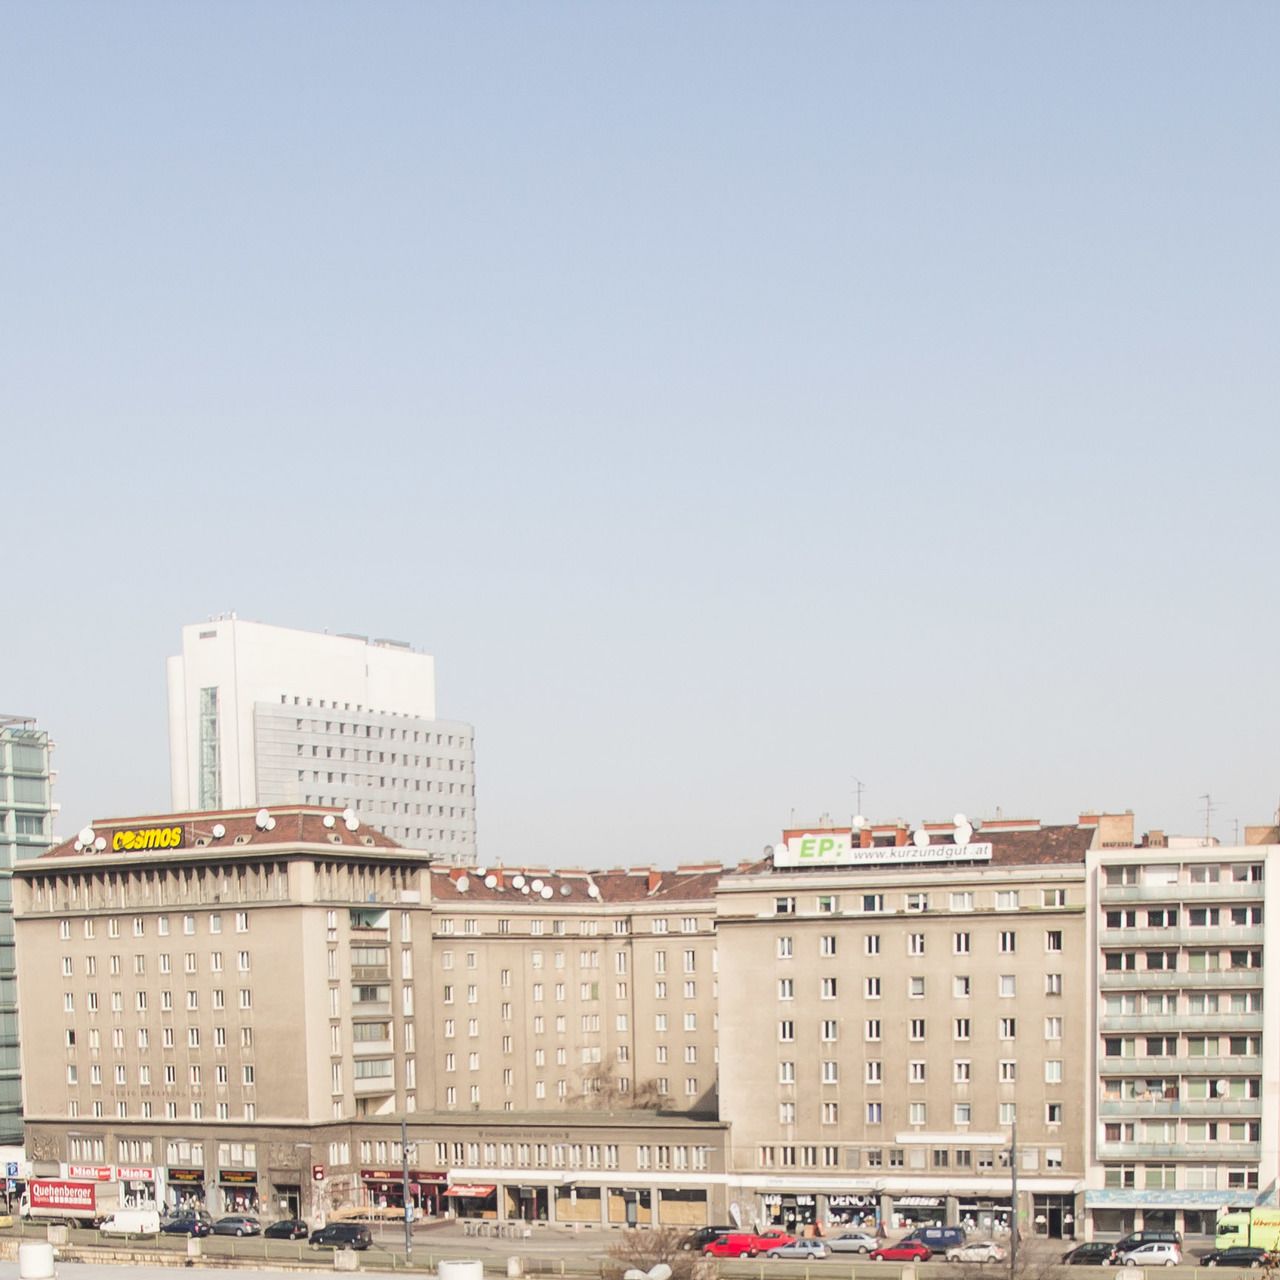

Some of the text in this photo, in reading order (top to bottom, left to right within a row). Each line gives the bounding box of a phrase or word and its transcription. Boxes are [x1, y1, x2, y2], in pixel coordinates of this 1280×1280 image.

[799, 838, 843, 858] EP:
[853, 843, 989, 860] www.kurzundgut.at
[121, 1168, 150, 1178] Miele
[33, 1184, 91, 1199] Quehenberger
[830, 1195, 876, 1206] DENON
